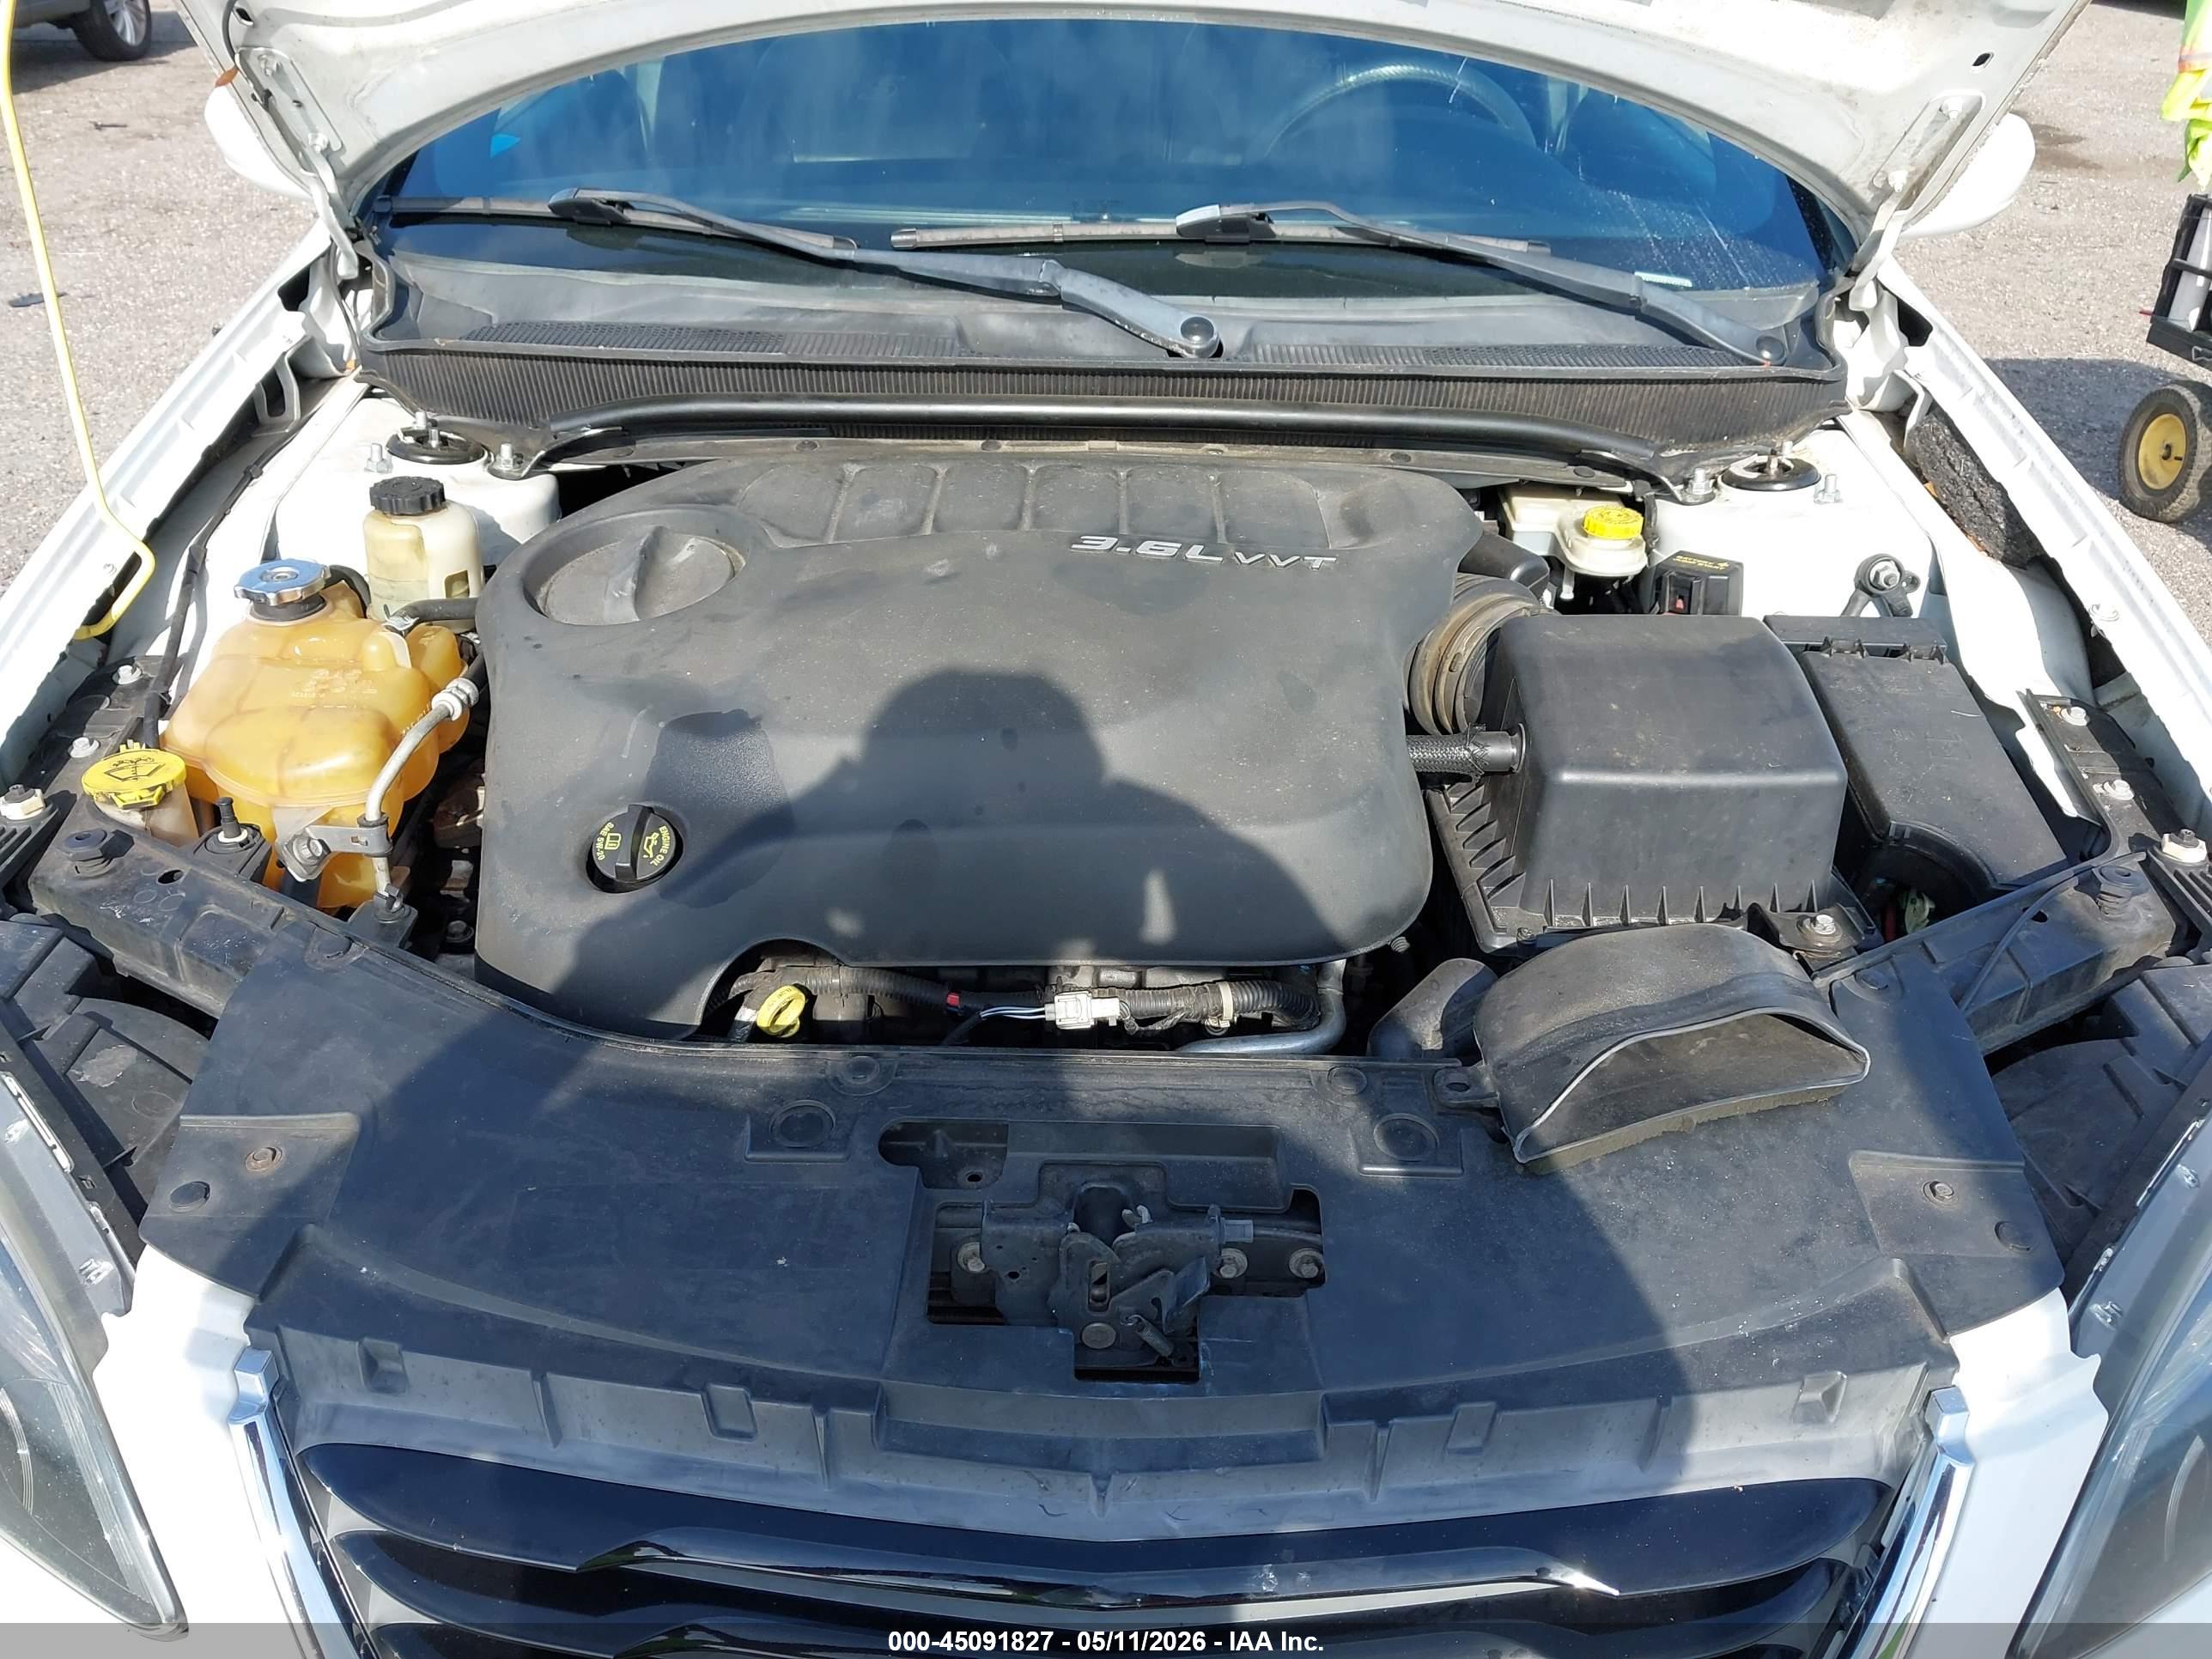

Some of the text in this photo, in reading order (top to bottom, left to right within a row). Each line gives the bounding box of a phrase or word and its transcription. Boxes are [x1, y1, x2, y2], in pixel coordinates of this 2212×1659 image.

[1072, 535, 1337, 569] 3.6L VVT
[595, 822, 615, 860] SAE 5W-20
[649, 825, 671, 866] ENGINE OIL
